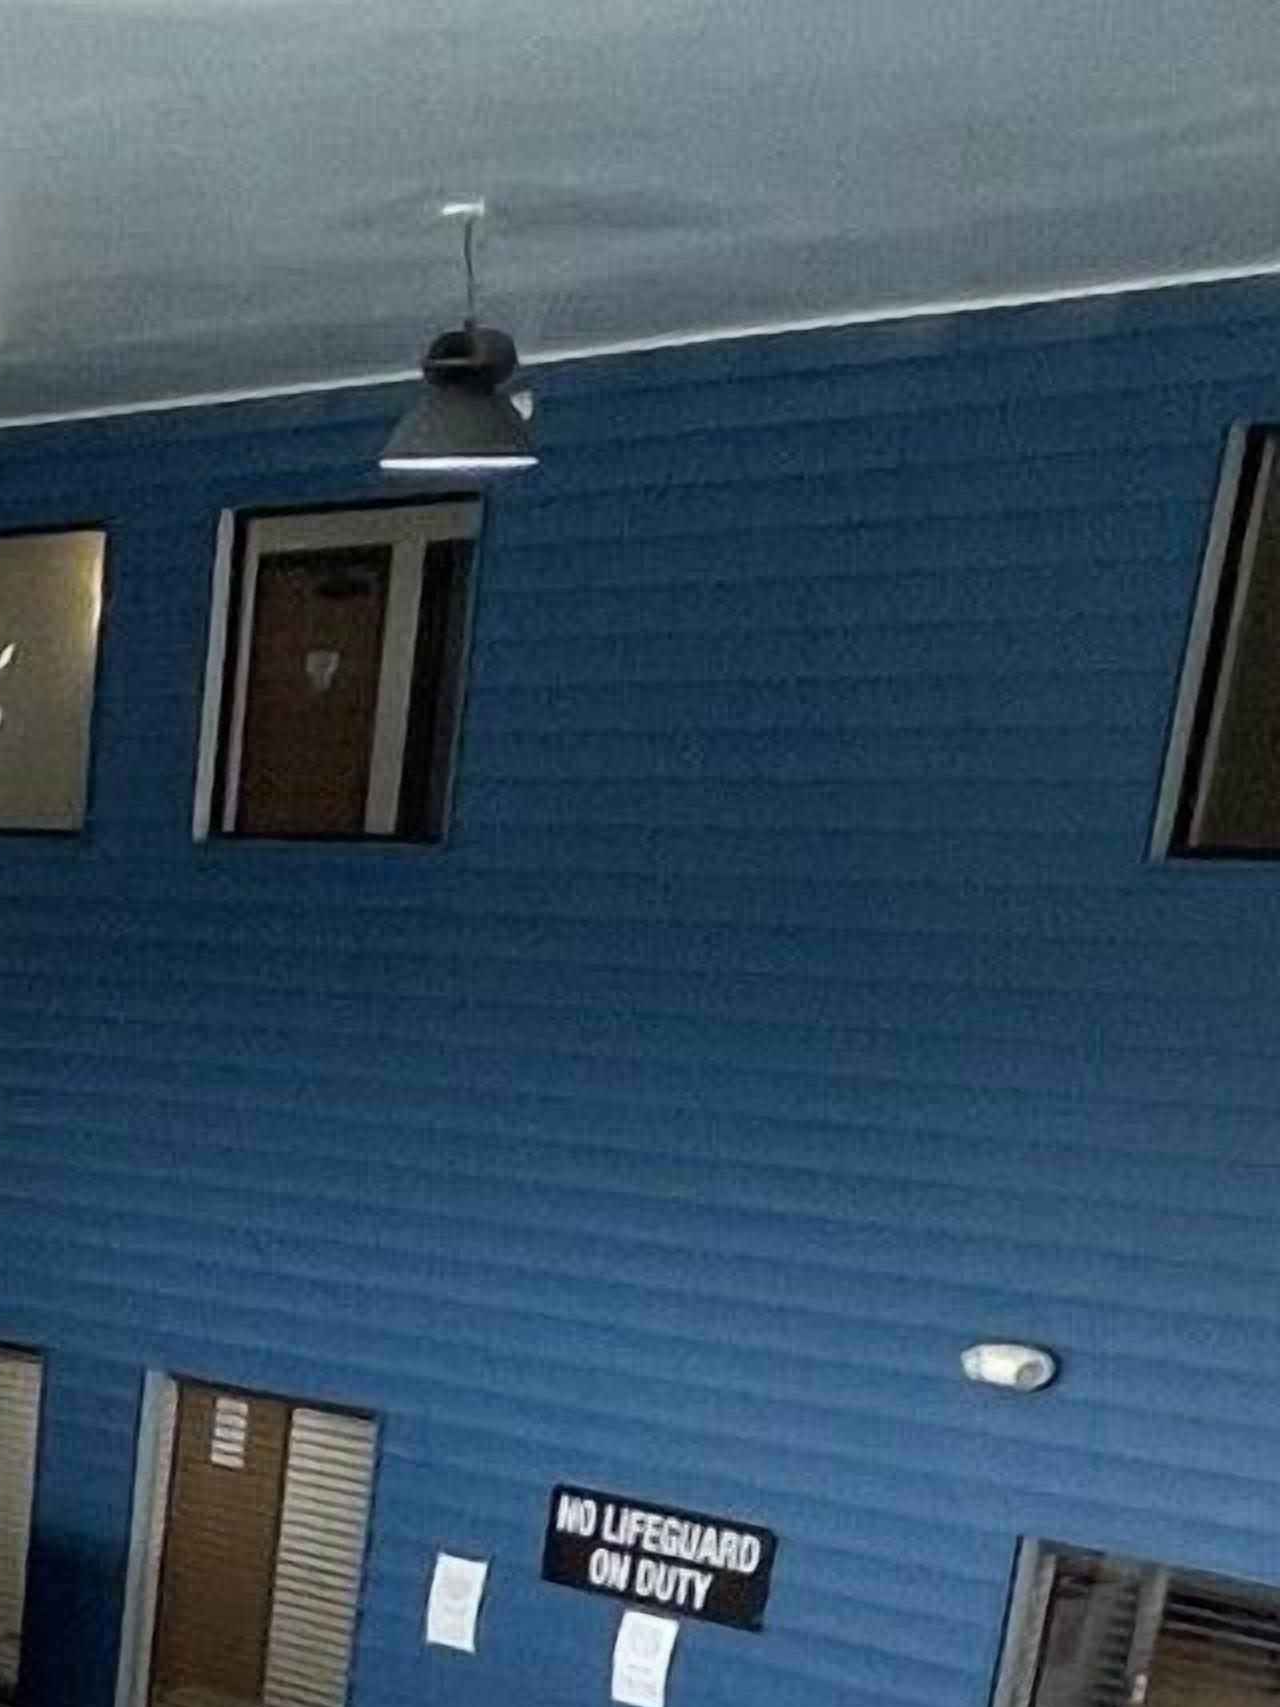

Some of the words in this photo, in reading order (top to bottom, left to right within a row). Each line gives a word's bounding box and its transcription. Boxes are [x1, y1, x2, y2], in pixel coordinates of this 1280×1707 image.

[556, 1494, 597, 1537] NO
[602, 1504, 761, 1573] LIFEGUARD
[591, 1548, 631, 1591] ON
[636, 1559, 713, 1610] DUTY
